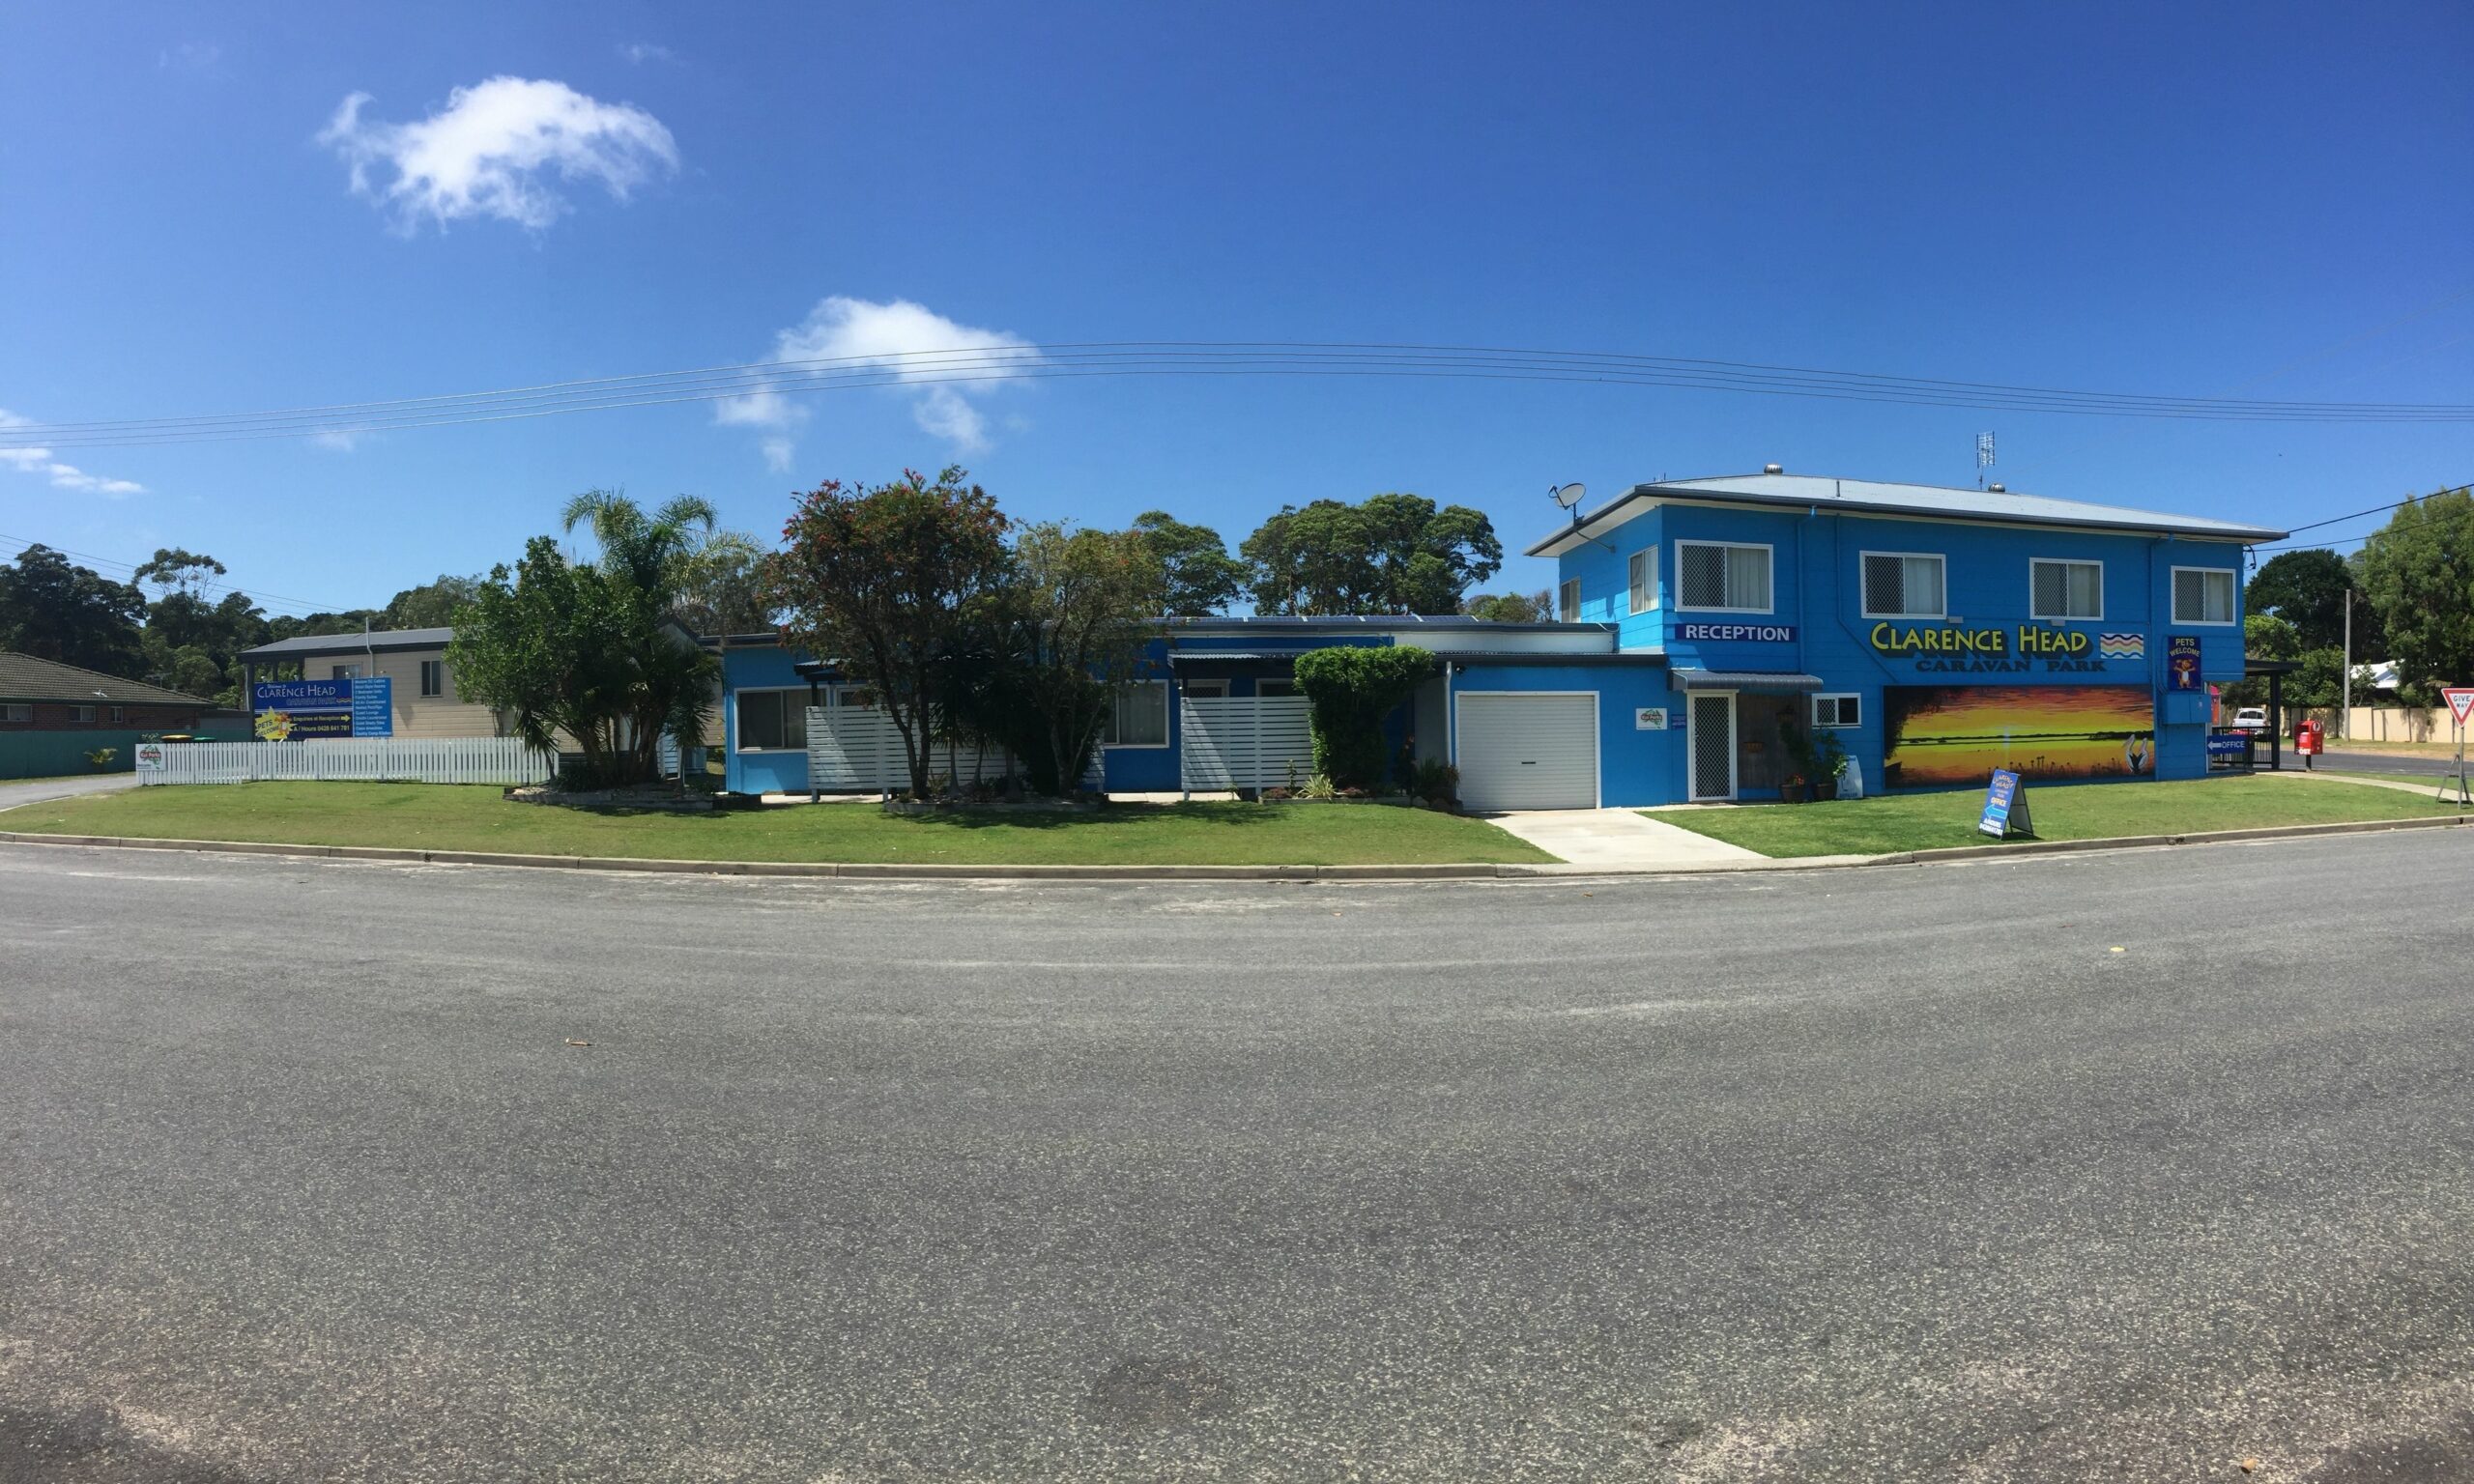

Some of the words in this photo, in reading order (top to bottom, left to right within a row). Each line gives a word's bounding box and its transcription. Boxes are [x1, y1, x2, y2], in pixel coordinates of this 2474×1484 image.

[1685, 624, 1790, 642] RECEPTION
[1870, 622, 2003, 652] CLARENCE
[2019, 625, 2088, 653] HEAD
[2175, 638, 2195, 646] PETS
[2170, 646, 2201, 657] WELCOME
[1914, 660, 2032, 672] CARAVAN
[2046, 660, 2108, 673] PARK
[257, 686, 305, 699] CLARENCE
[308, 684, 336, 697] HEAD
[258, 719, 273, 730] PETS
[1991, 797, 2008, 807] OFFICE
